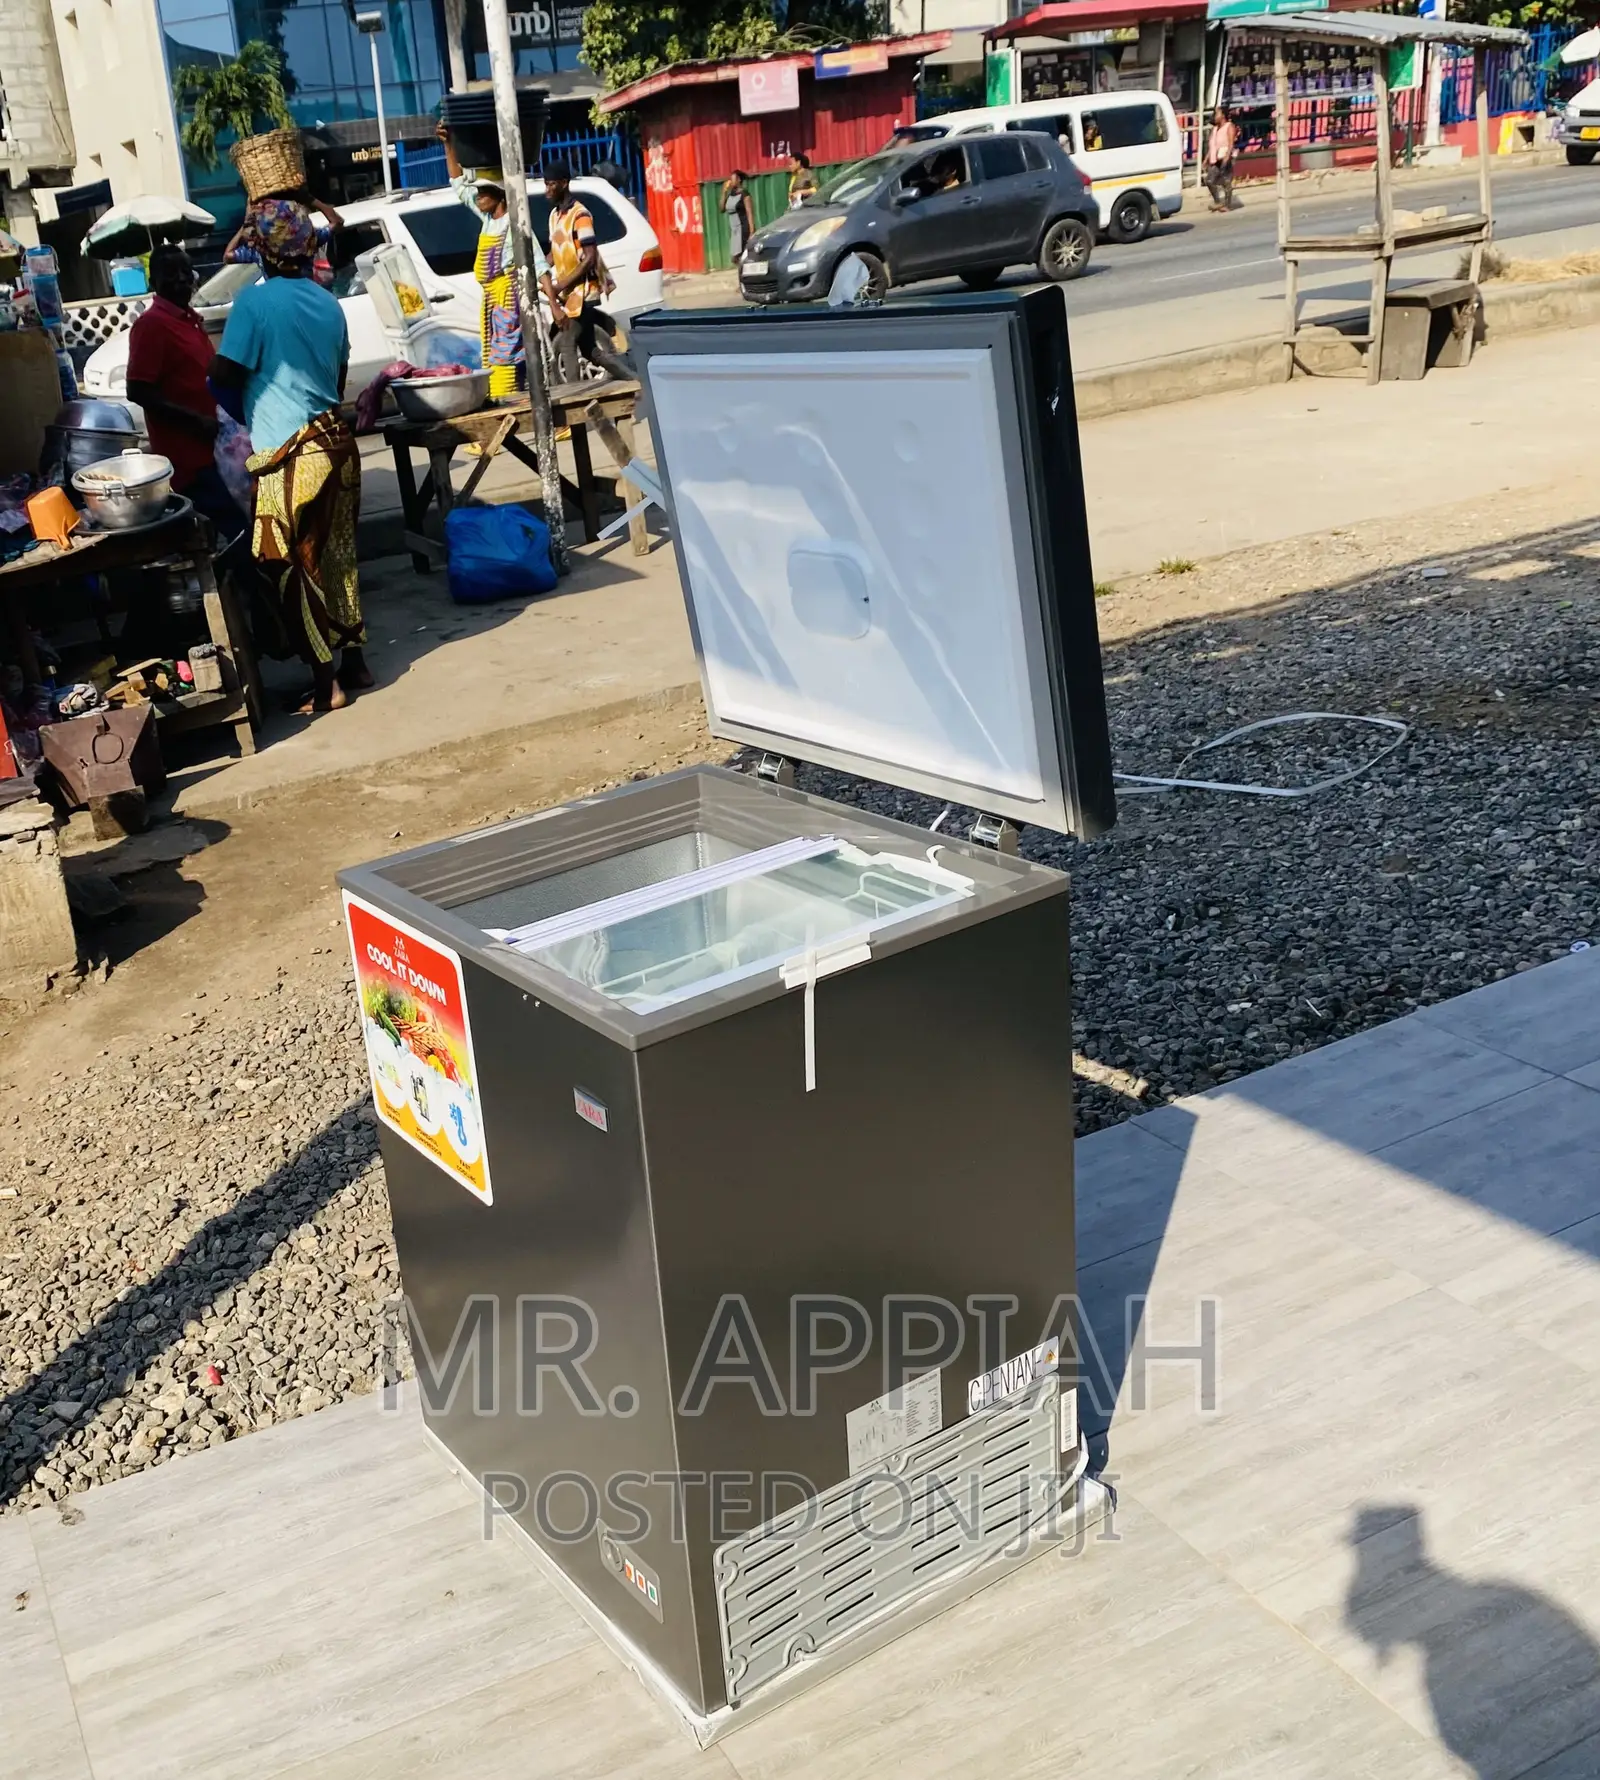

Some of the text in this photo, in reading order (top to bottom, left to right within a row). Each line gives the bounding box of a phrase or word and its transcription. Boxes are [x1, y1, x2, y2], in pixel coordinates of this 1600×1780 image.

[507, 1, 551, 36] umb
[366, 942, 448, 1006] COOL IT DOWN
